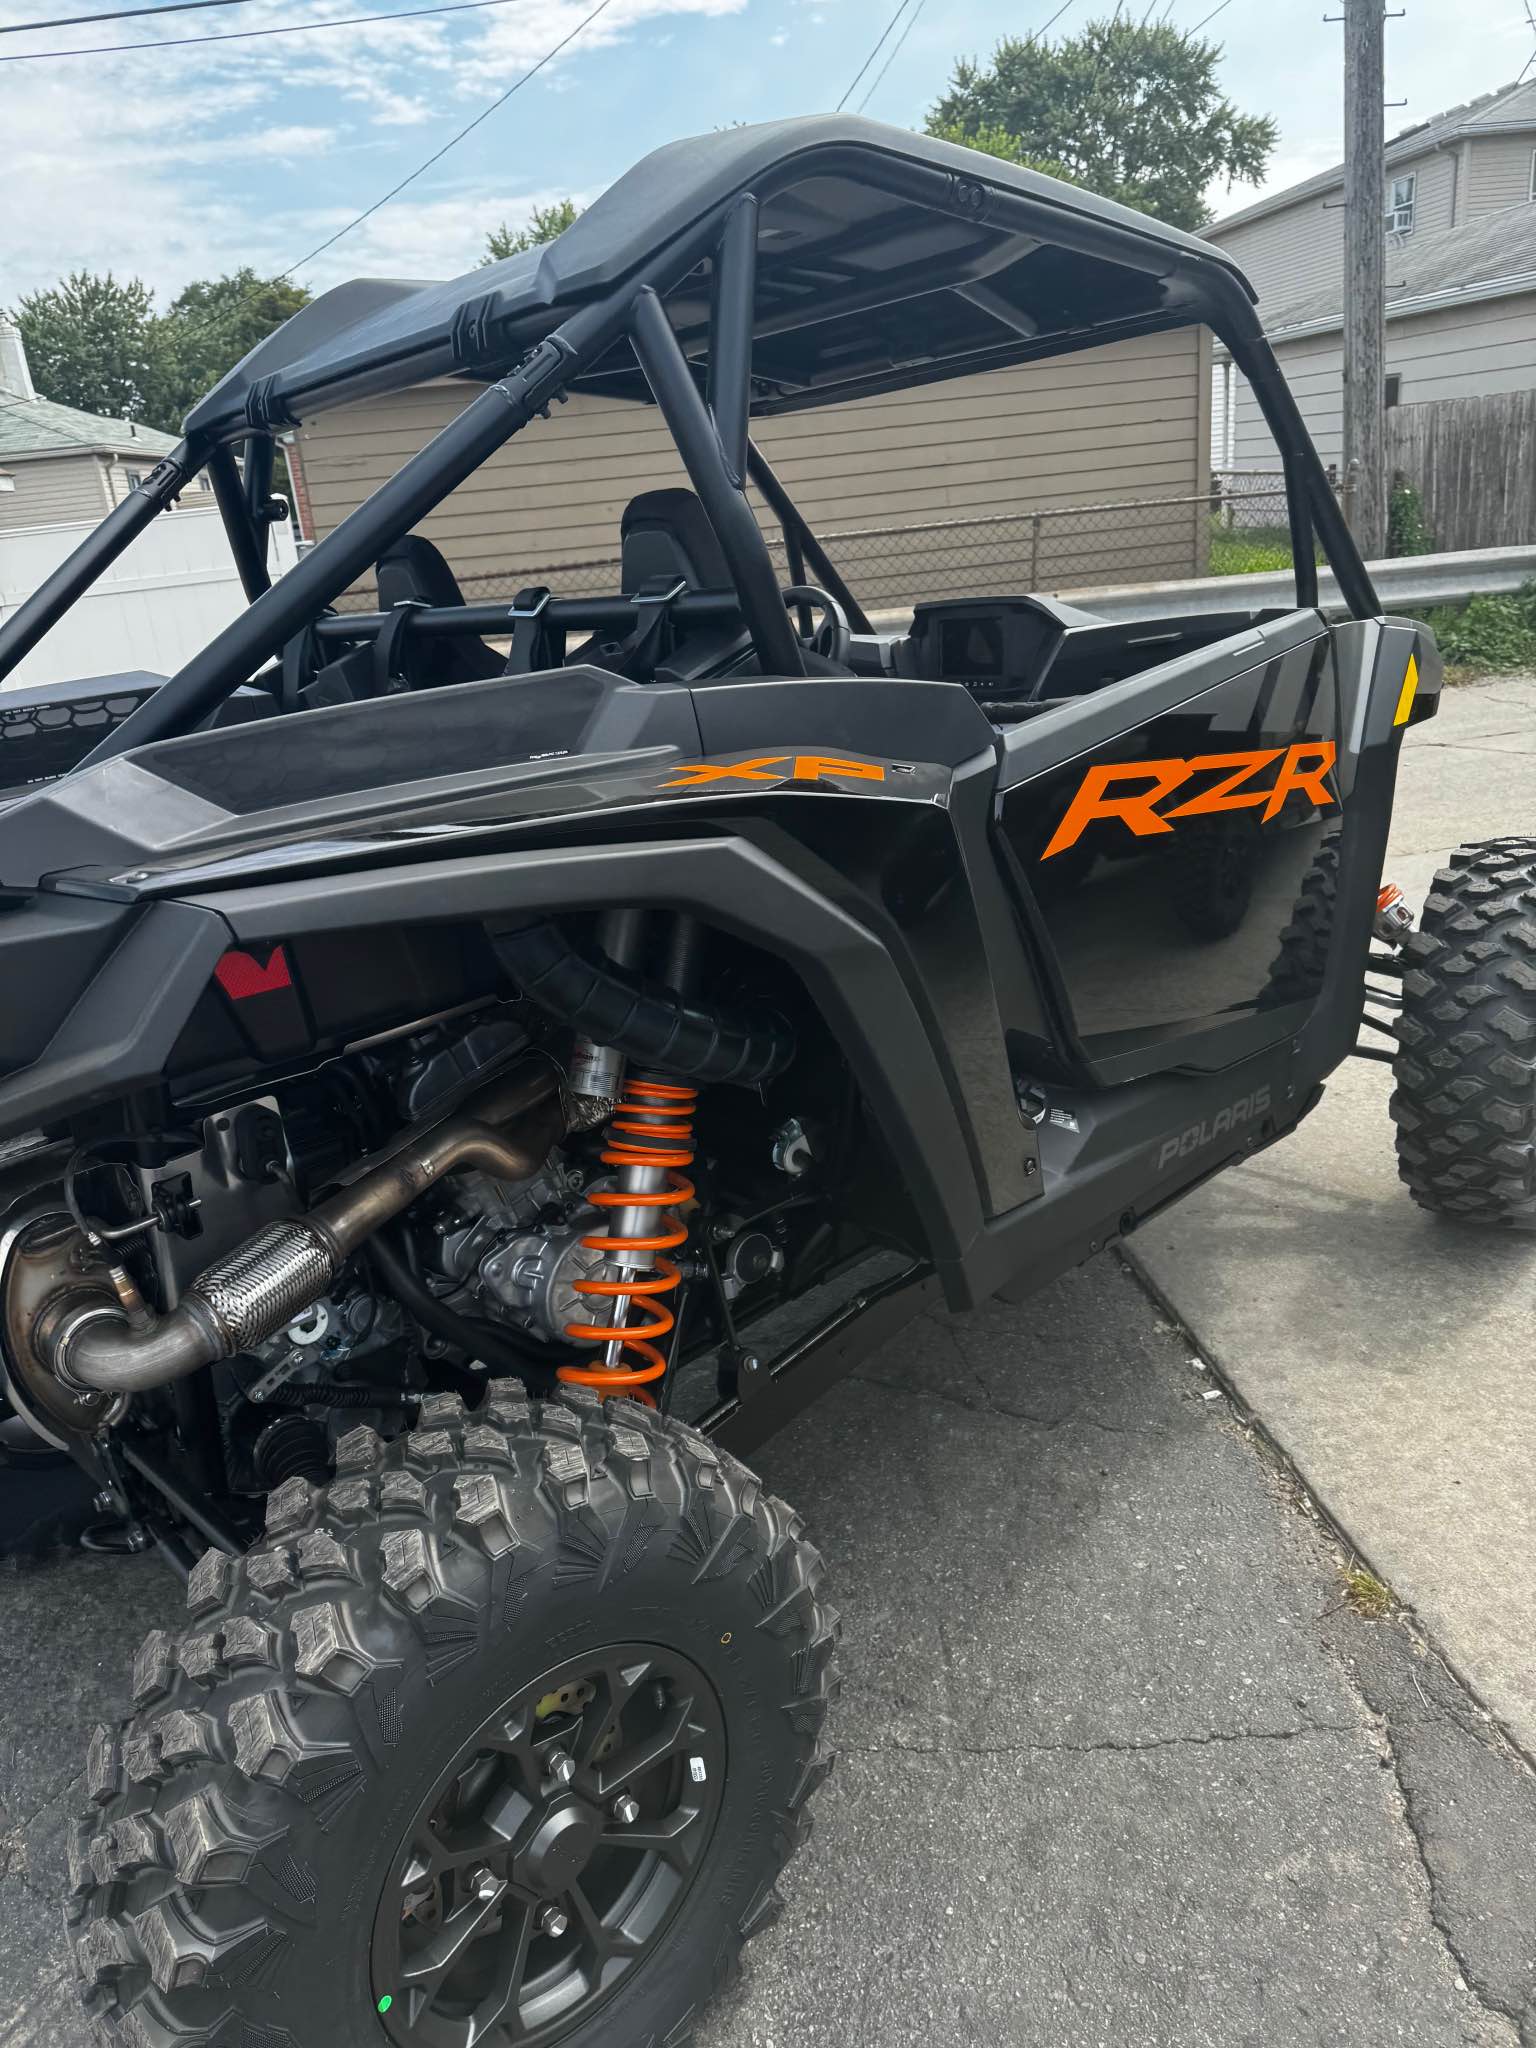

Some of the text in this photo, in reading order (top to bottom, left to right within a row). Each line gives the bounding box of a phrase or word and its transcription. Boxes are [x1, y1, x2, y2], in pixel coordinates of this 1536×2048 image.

[655, 755, 885, 788] XP
[1040, 741, 1336, 861] RZR
[1157, 1084, 1272, 1169] POLARIS
